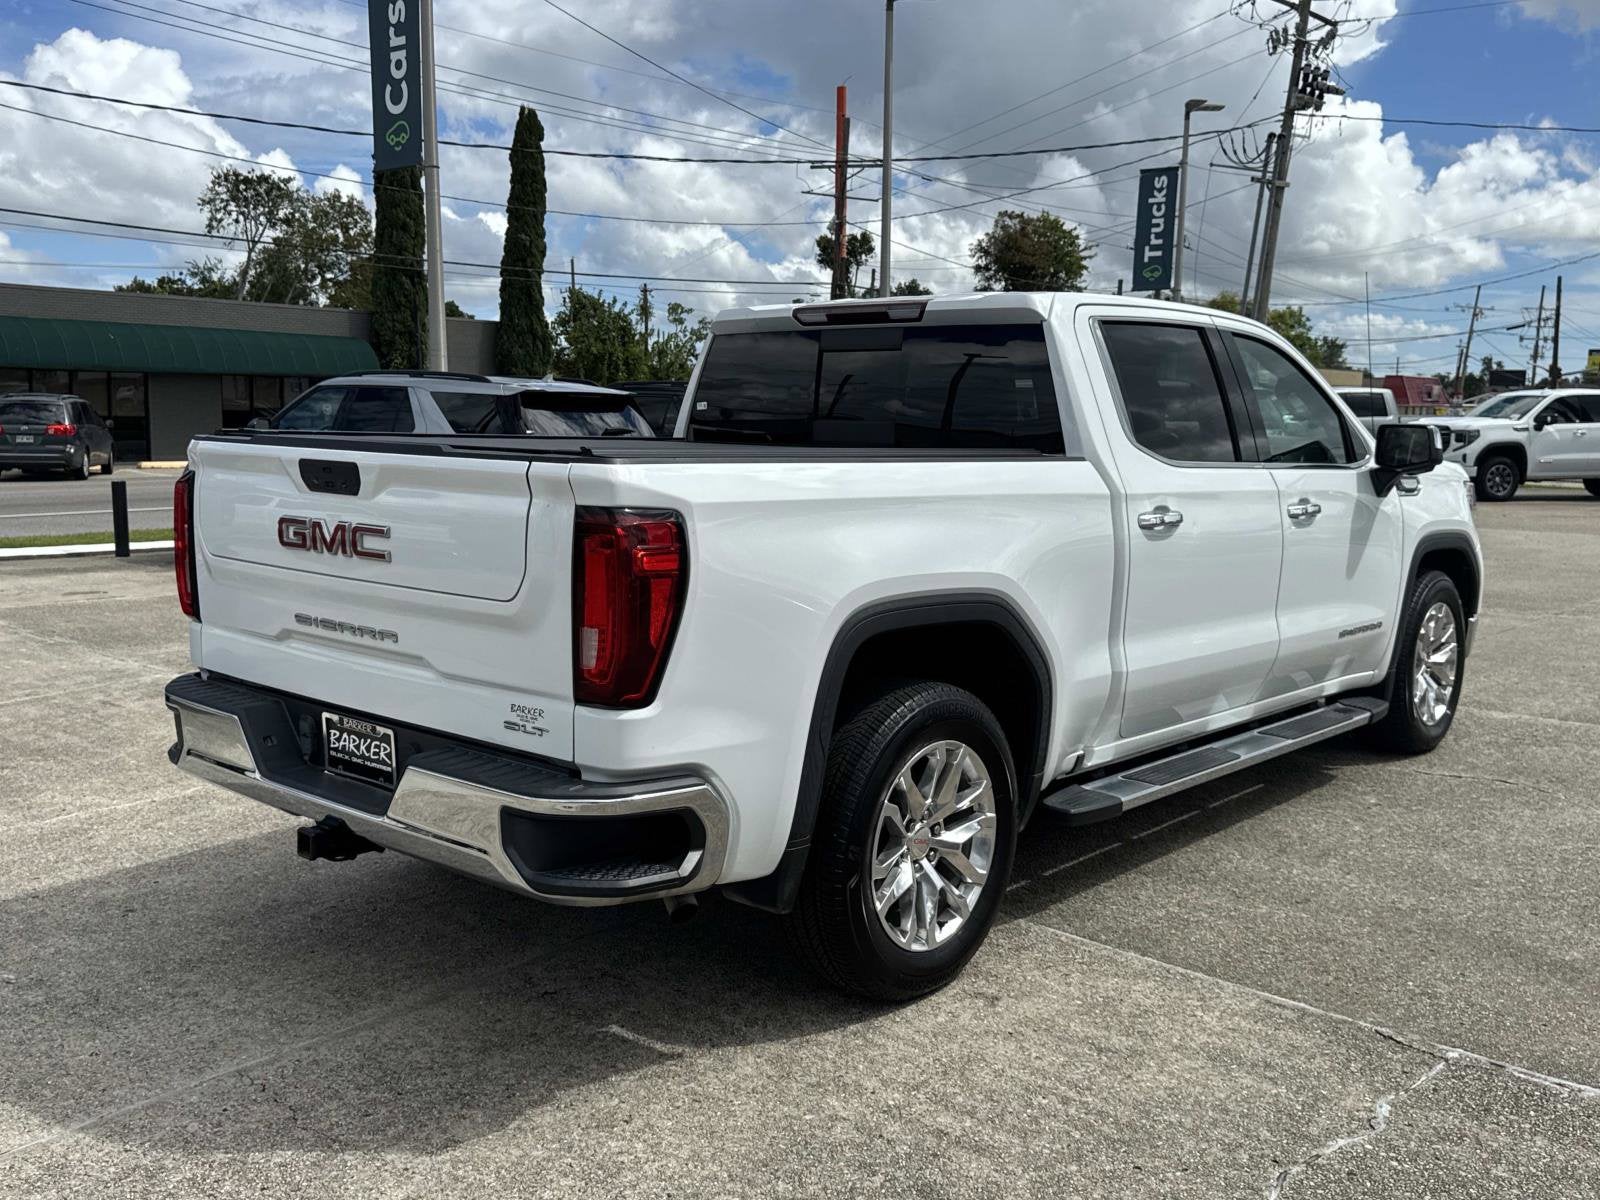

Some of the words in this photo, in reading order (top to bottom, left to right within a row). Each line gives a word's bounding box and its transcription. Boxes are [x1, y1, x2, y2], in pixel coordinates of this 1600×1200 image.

[384, 0, 409, 115] Cars
[1143, 174, 1168, 263] Trucks
[277, 514, 392, 563] GMC
[294, 612, 399, 644] SIERRA
[510, 703, 545, 719] BARKER
[329, 729, 392, 765] BARKER
